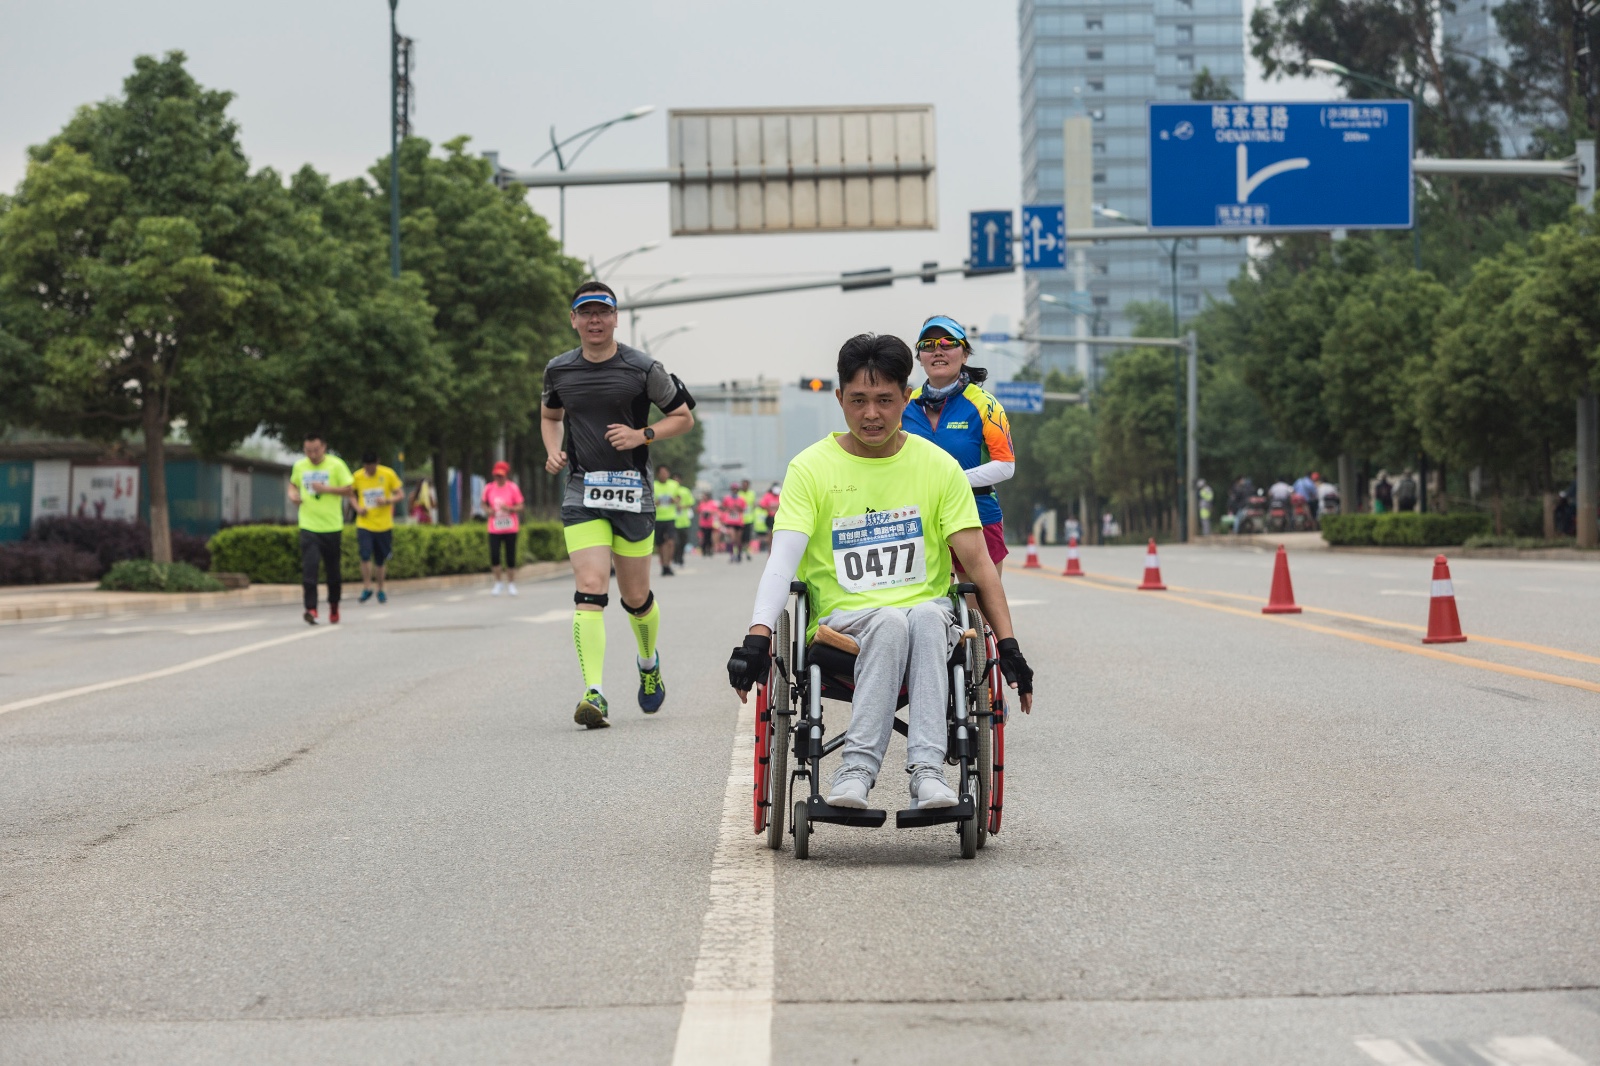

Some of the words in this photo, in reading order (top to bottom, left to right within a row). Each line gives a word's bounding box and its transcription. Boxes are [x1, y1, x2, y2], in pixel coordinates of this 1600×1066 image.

[1212, 106, 1289, 129] 陈家营路
[844, 542, 915, 581] 0477
